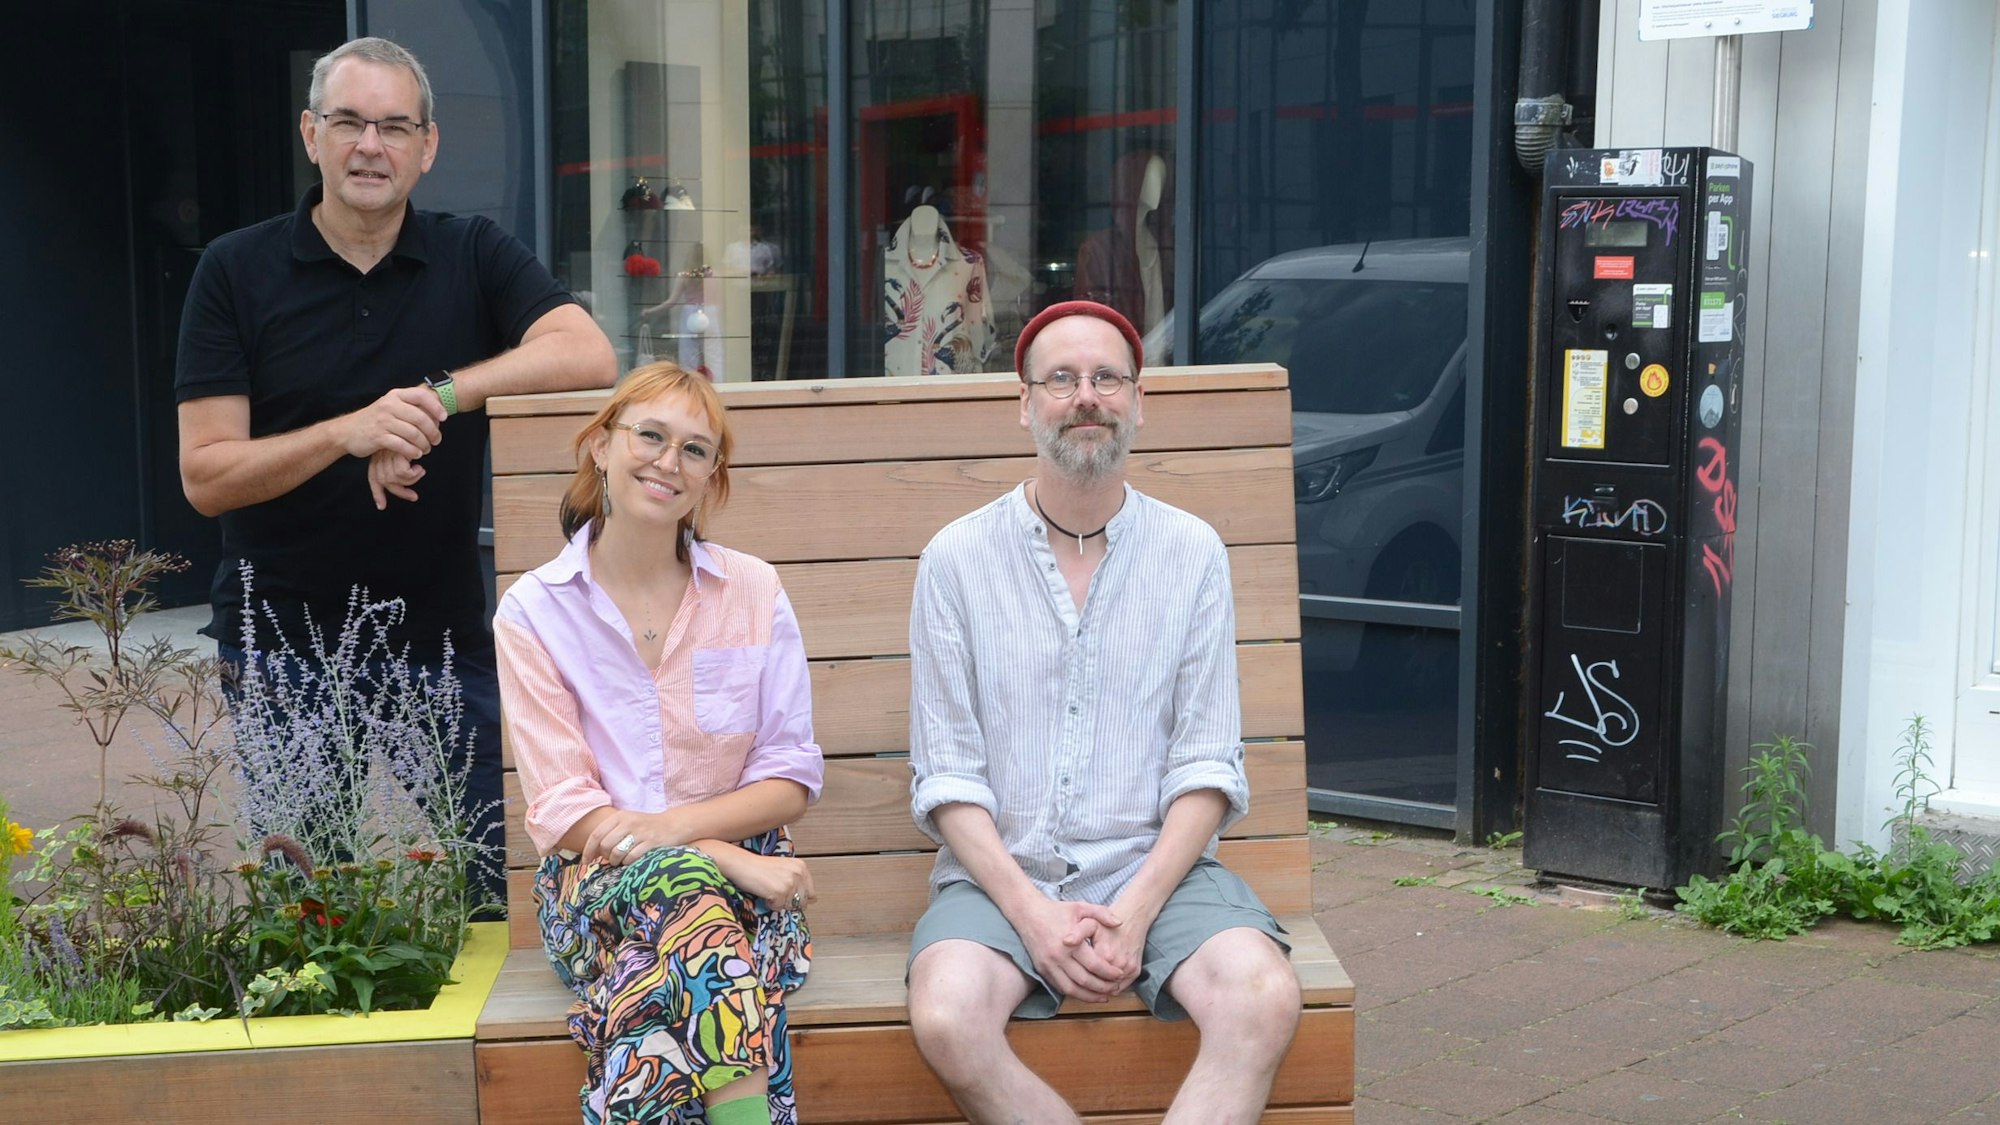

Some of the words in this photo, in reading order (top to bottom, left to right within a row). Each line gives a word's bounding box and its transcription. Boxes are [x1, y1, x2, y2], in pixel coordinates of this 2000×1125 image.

[1708, 182, 1731, 193] Parken
[1708, 195, 1720, 205] per
[1720, 193, 1734, 205] App
